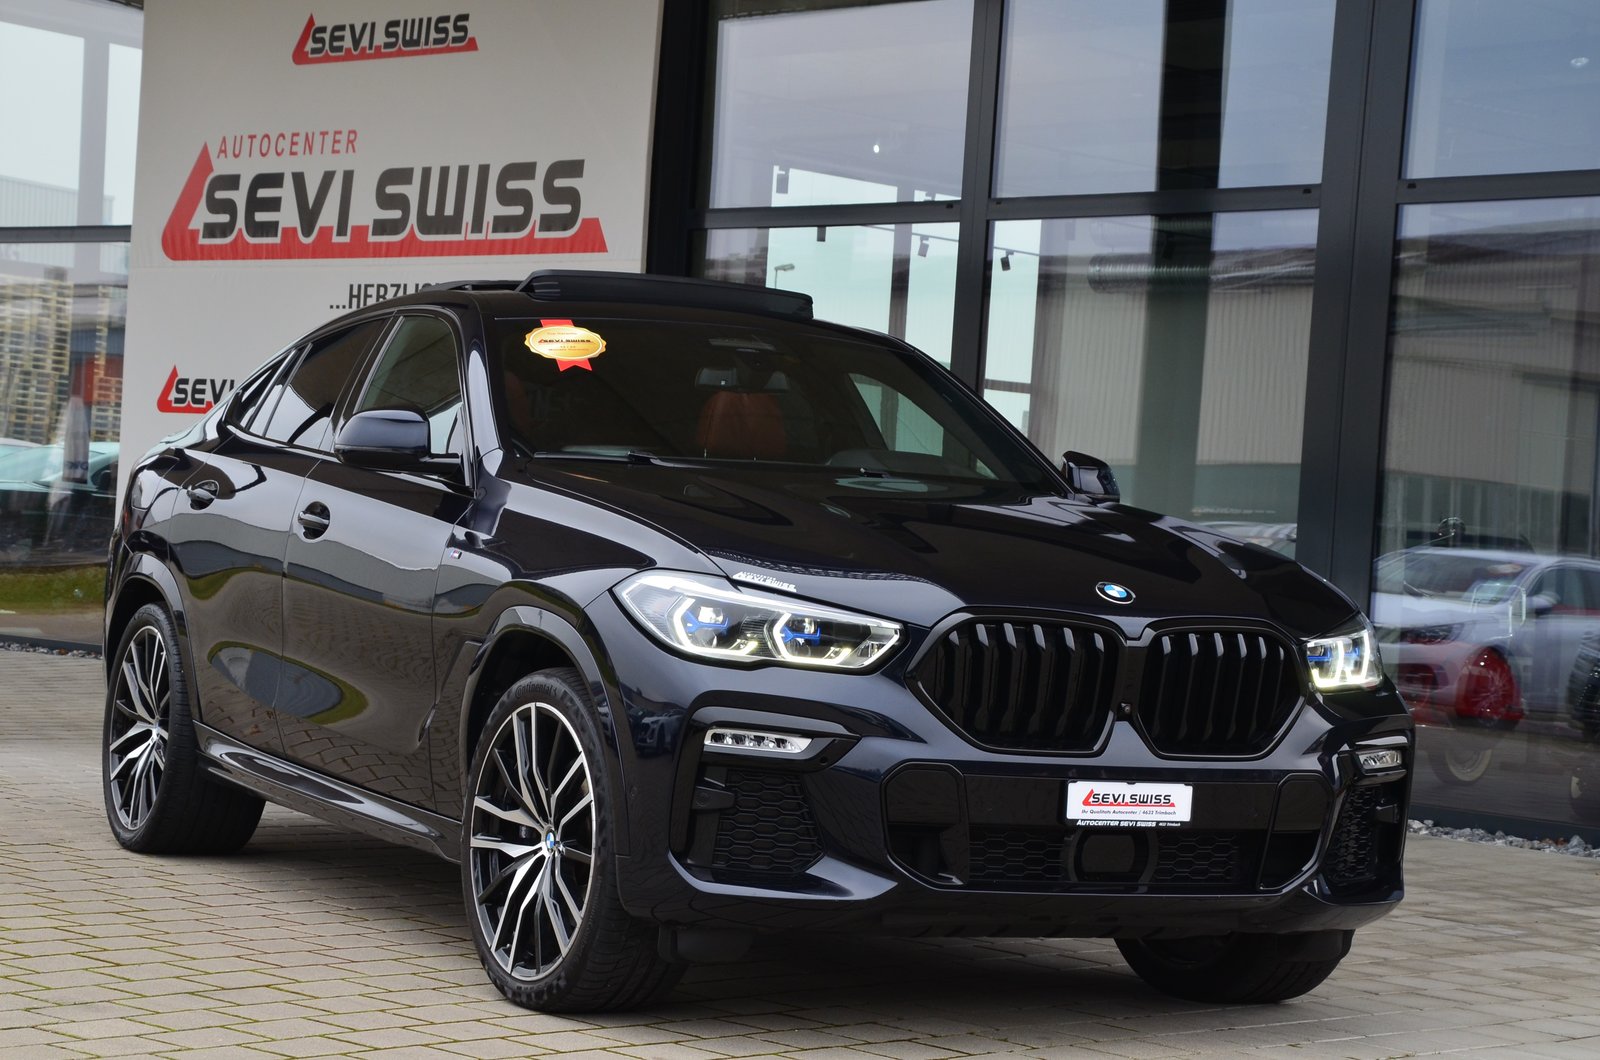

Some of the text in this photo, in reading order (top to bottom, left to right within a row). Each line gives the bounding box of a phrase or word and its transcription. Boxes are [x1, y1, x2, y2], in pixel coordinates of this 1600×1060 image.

[309, 13, 470, 56] SEVI SWISS
[216, 129, 358, 159] AUTOCENTER
[201, 158, 586, 240] SEVI SWISS
[1091, 793, 1172, 805] SEVI SWISS
